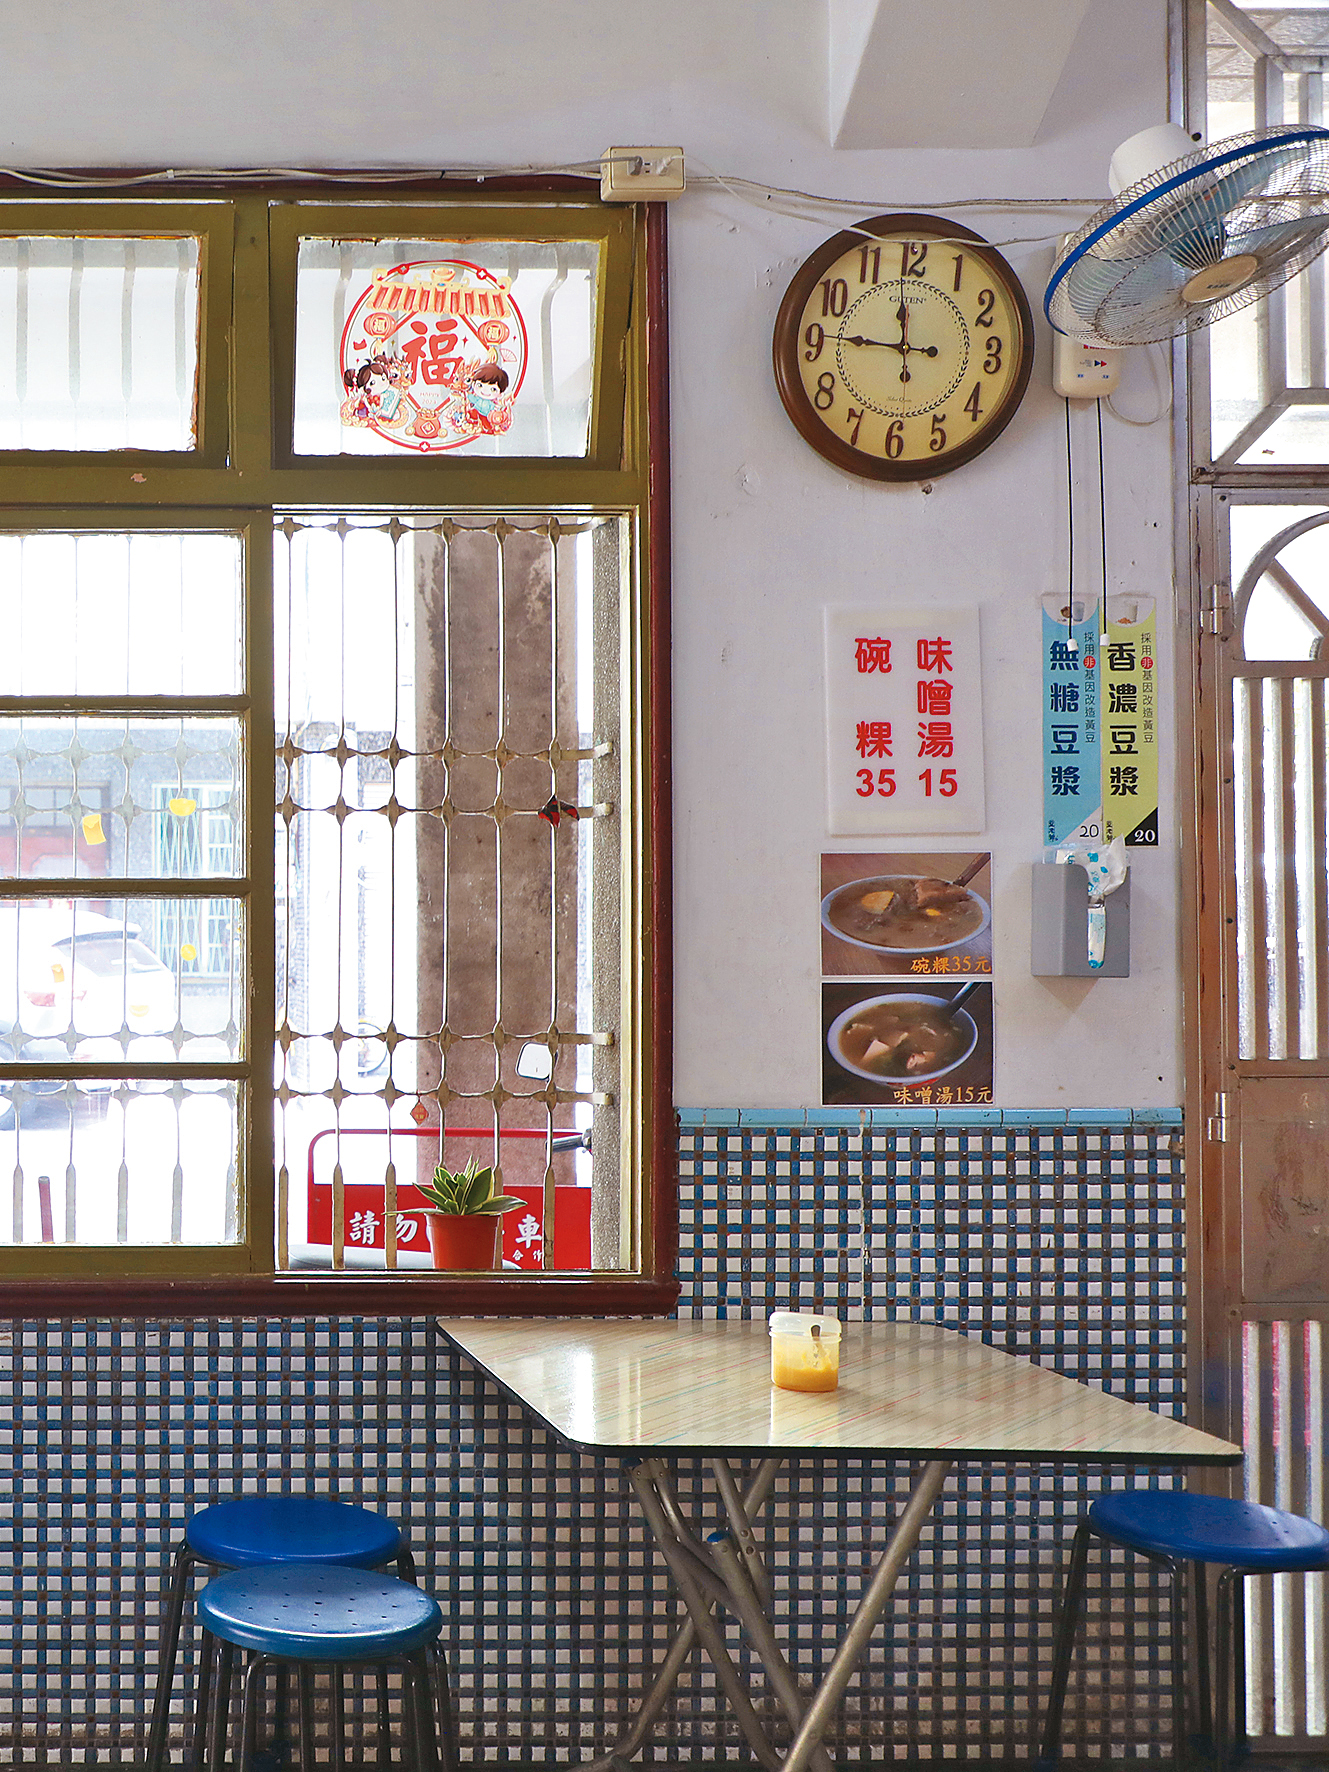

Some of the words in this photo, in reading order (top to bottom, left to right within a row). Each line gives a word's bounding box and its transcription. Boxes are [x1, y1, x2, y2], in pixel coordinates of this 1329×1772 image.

[858, 245, 881, 284] 11
[900, 241, 928, 277] 12
[952, 254, 963, 291] 1
[820, 278, 848, 317] 10
[975, 289, 995, 328] 2
[402, 319, 464, 385] 福
[805, 323, 824, 362] 9
[983, 336, 1002, 374] 3
[814, 371, 835, 410] 8
[964, 381, 983, 422] 4
[847, 407, 864, 446] 7
[885, 419, 904, 459] 6
[929, 413, 947, 451] 5
[854, 636, 893, 759] 碗粿
[916, 636, 954, 758] 味噌湯
[1049, 640, 1081, 796] 無糖豆漿
[1107, 642, 1139, 796] 香濃豆漿
[856, 769, 897, 797] 35
[918, 769, 958, 797] 15
[1079, 824, 1099, 838] 20
[1134, 829, 1156, 843] 20
[910, 956, 992, 974] 碗粿35元
[893, 1086, 993, 1105] 味噌湯15元
